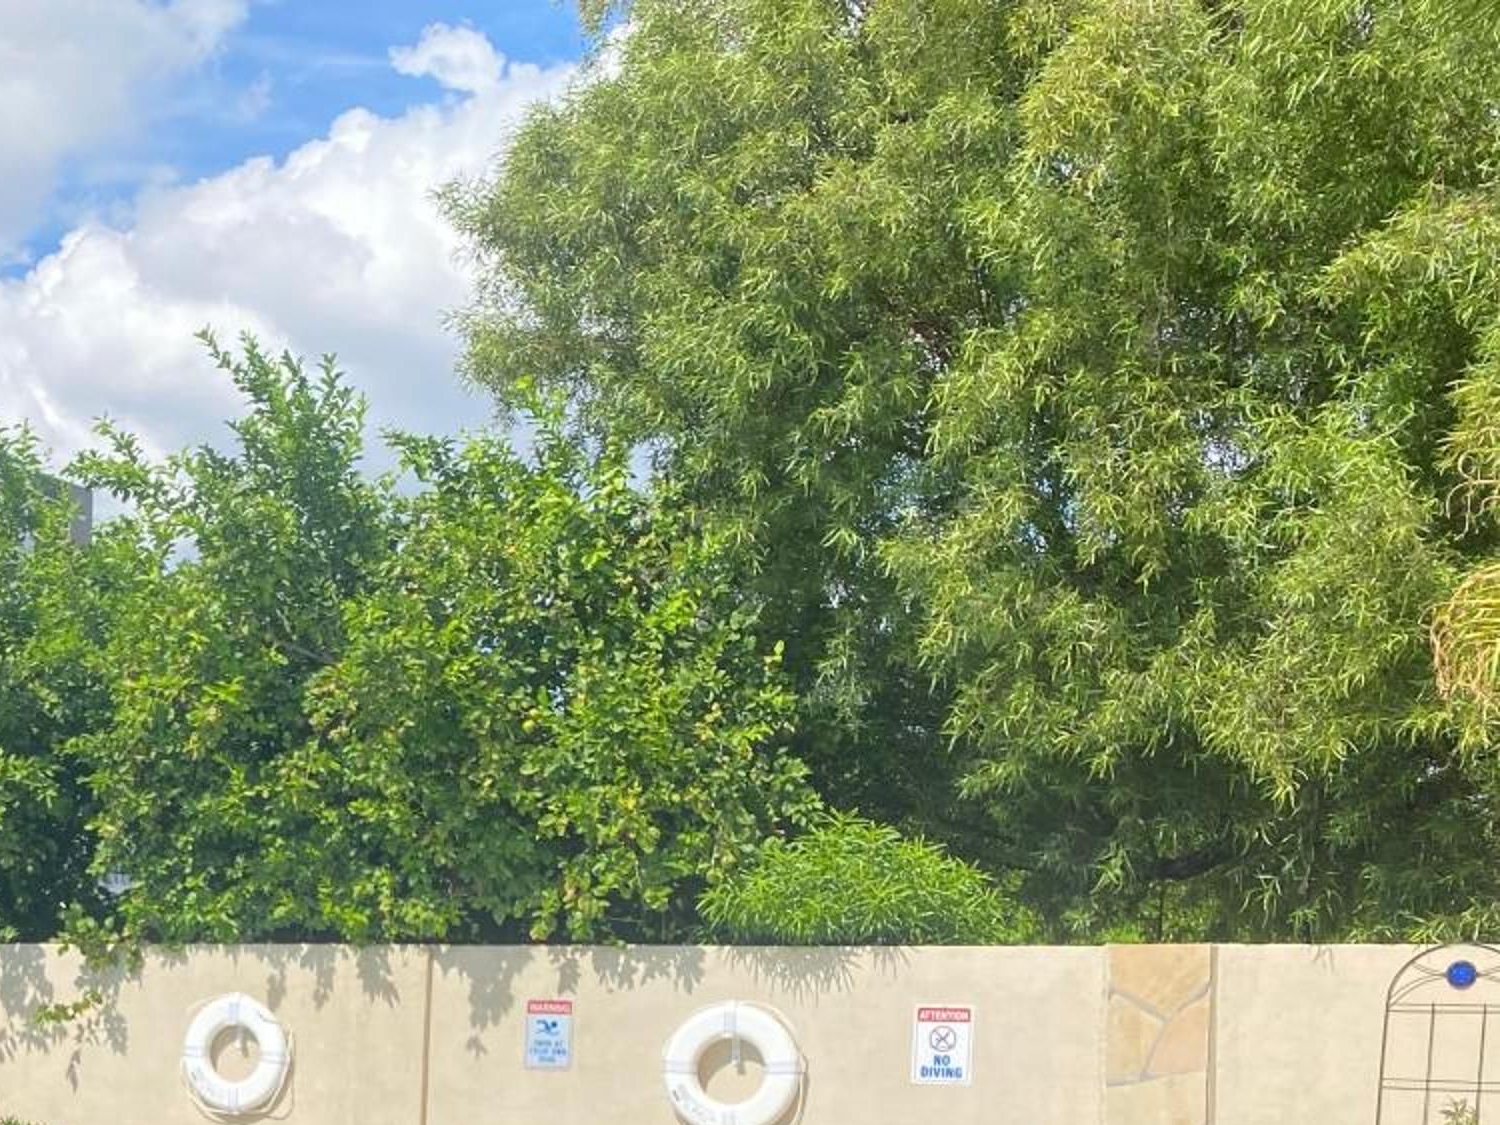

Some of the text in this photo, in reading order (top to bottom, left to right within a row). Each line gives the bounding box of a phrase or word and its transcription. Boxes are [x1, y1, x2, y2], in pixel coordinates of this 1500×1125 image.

[920, 1009, 968, 1020] ATTENTION
[933, 1055, 951, 1066] NO
[920, 1065, 963, 1078] DIVING
